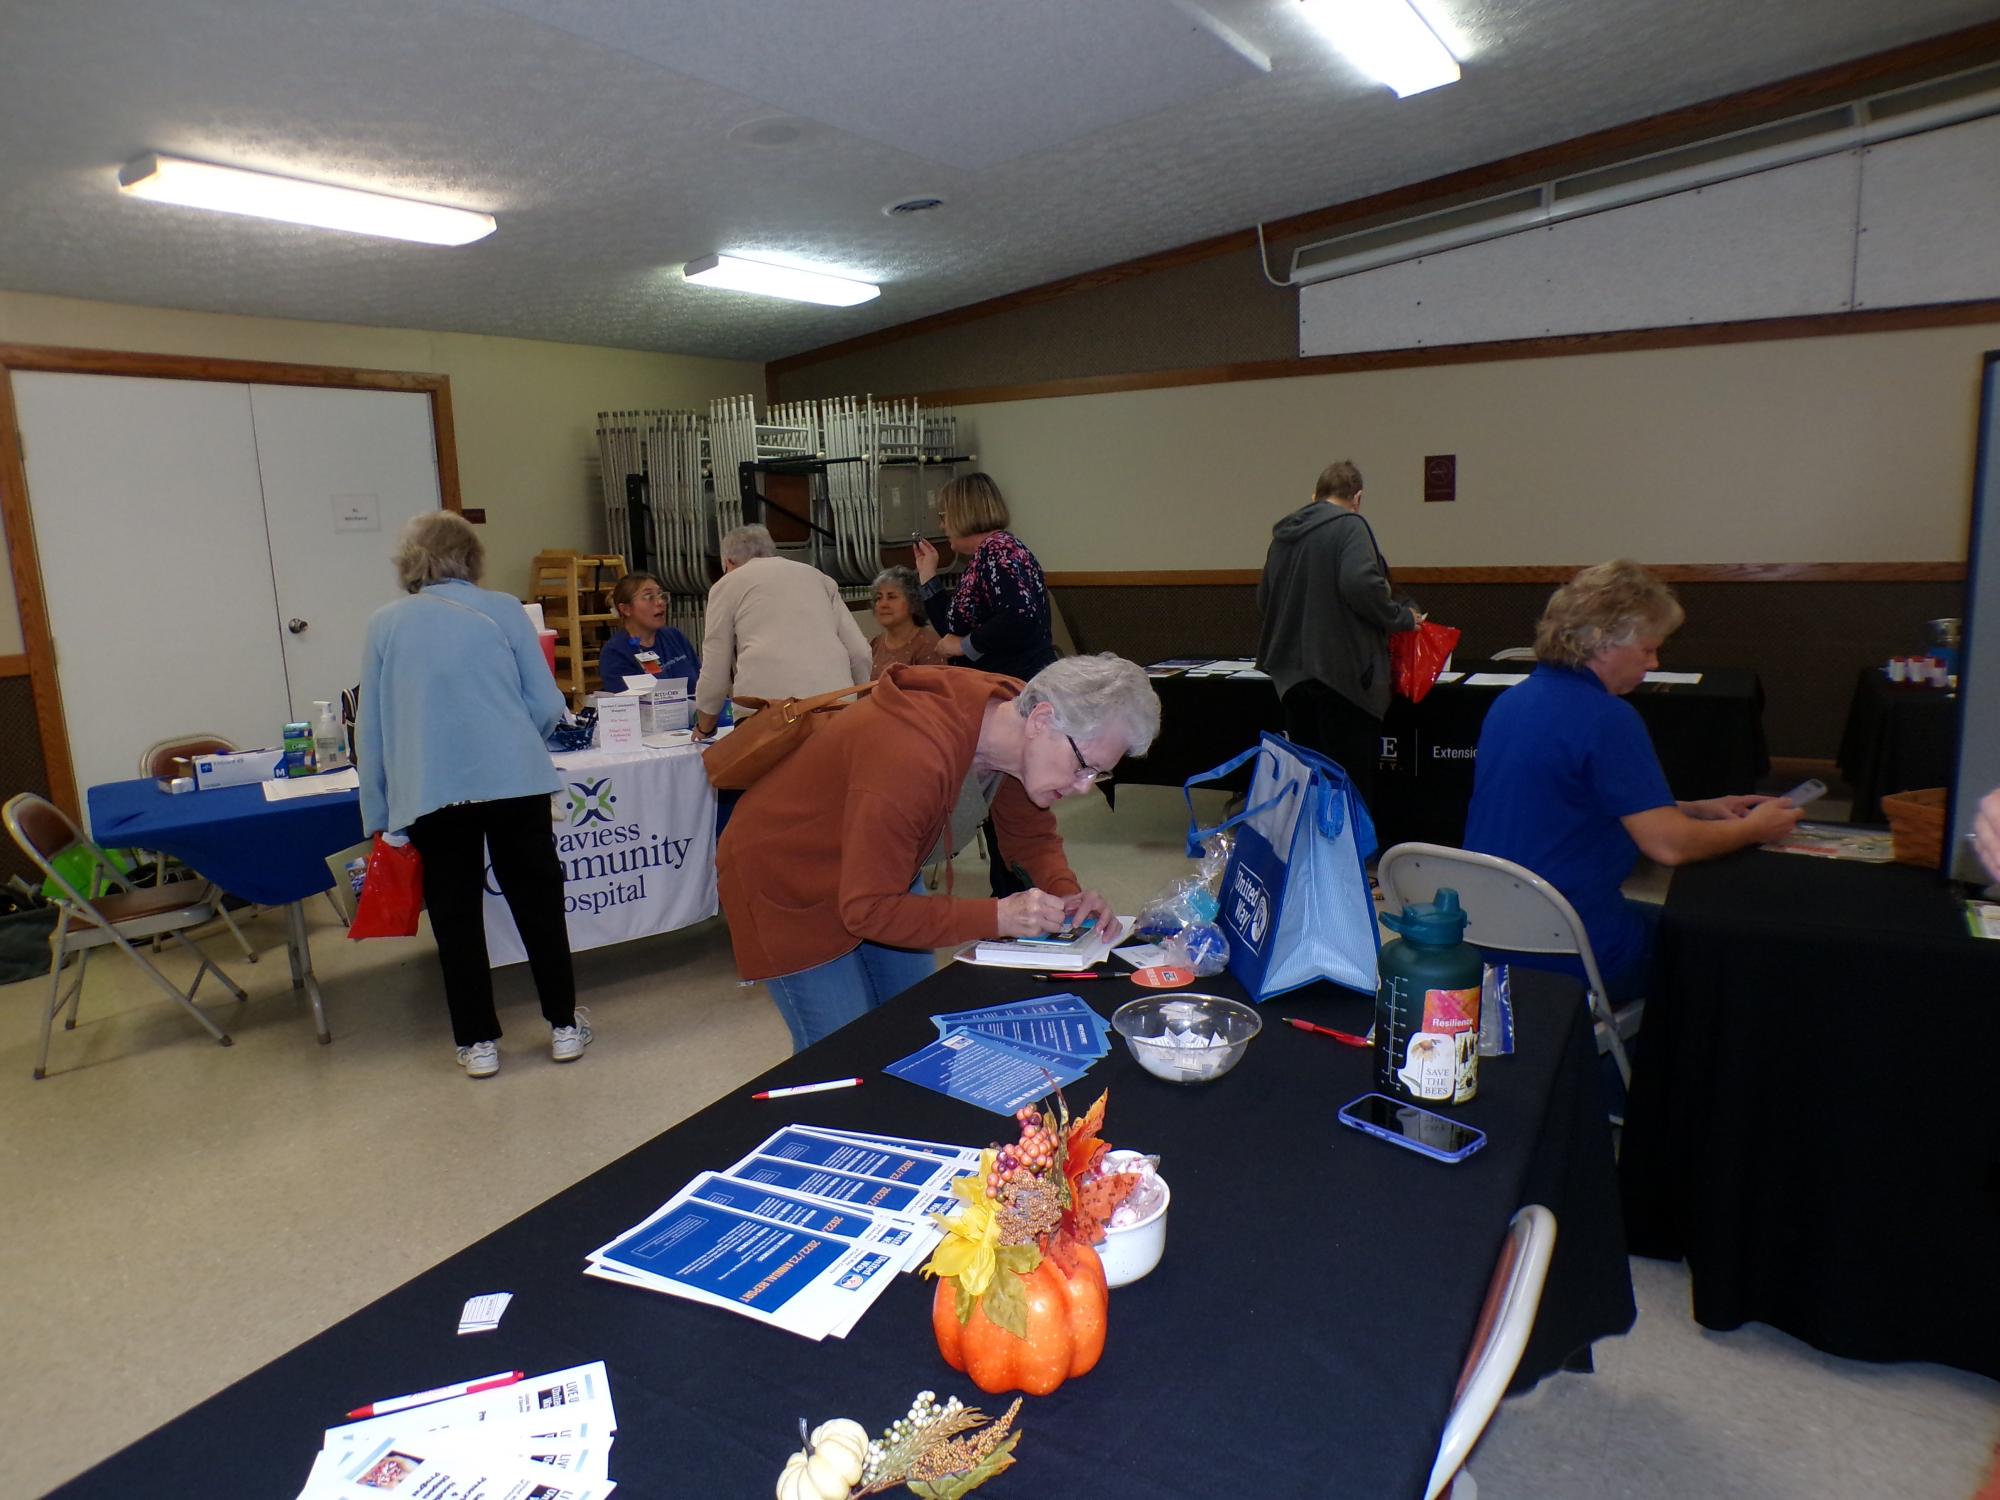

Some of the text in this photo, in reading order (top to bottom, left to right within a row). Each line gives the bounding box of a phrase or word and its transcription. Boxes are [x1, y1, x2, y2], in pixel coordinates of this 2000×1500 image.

[564, 875, 647, 914] ospital
[1234, 869, 1261, 907] United
[1234, 898, 1251, 931] Way
[1425, 1067, 1450, 1077] SAVE
[1425, 1077, 1446, 1086] THE
[1424, 1086, 1449, 1095] BEES
